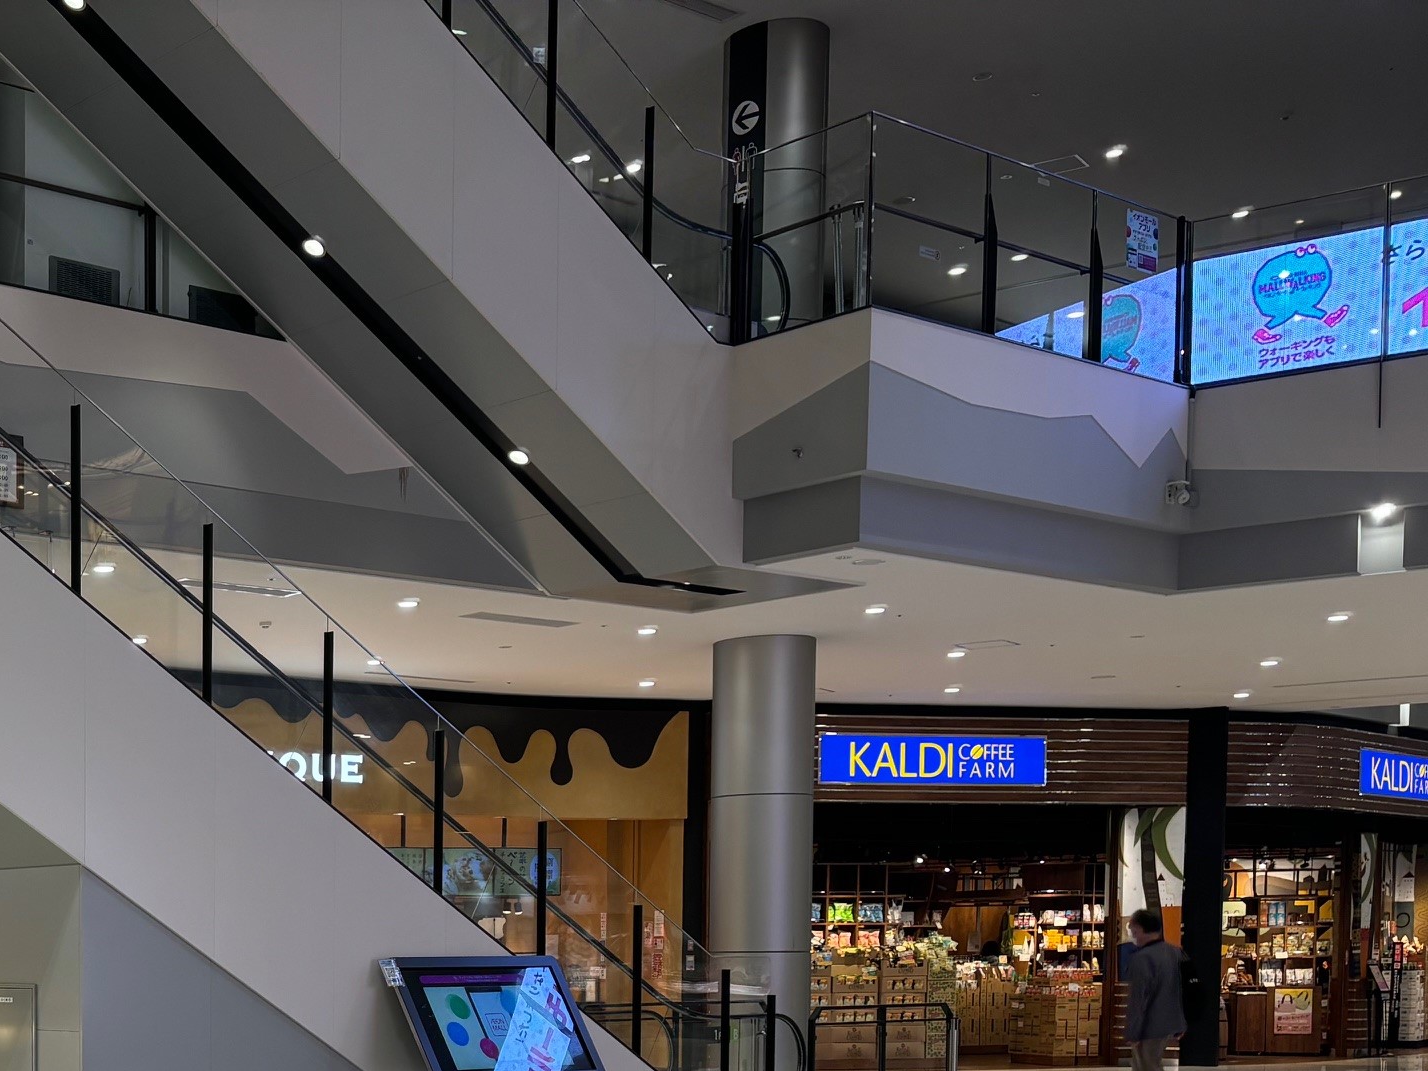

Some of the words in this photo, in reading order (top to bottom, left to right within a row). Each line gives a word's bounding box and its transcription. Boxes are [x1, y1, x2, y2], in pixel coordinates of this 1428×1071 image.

[1138, 222, 1151, 233] アプリ
[1258, 335, 1336, 358] ウォーキングも
[1258, 346, 1335, 369] アプリで楽しく
[266, 750, 364, 784] QUE
[849, 741, 954, 778] KALDI
[958, 743, 1014, 761] COFFEE
[958, 761, 1014, 778] FARM
[1371, 756, 1414, 793] KALDI
